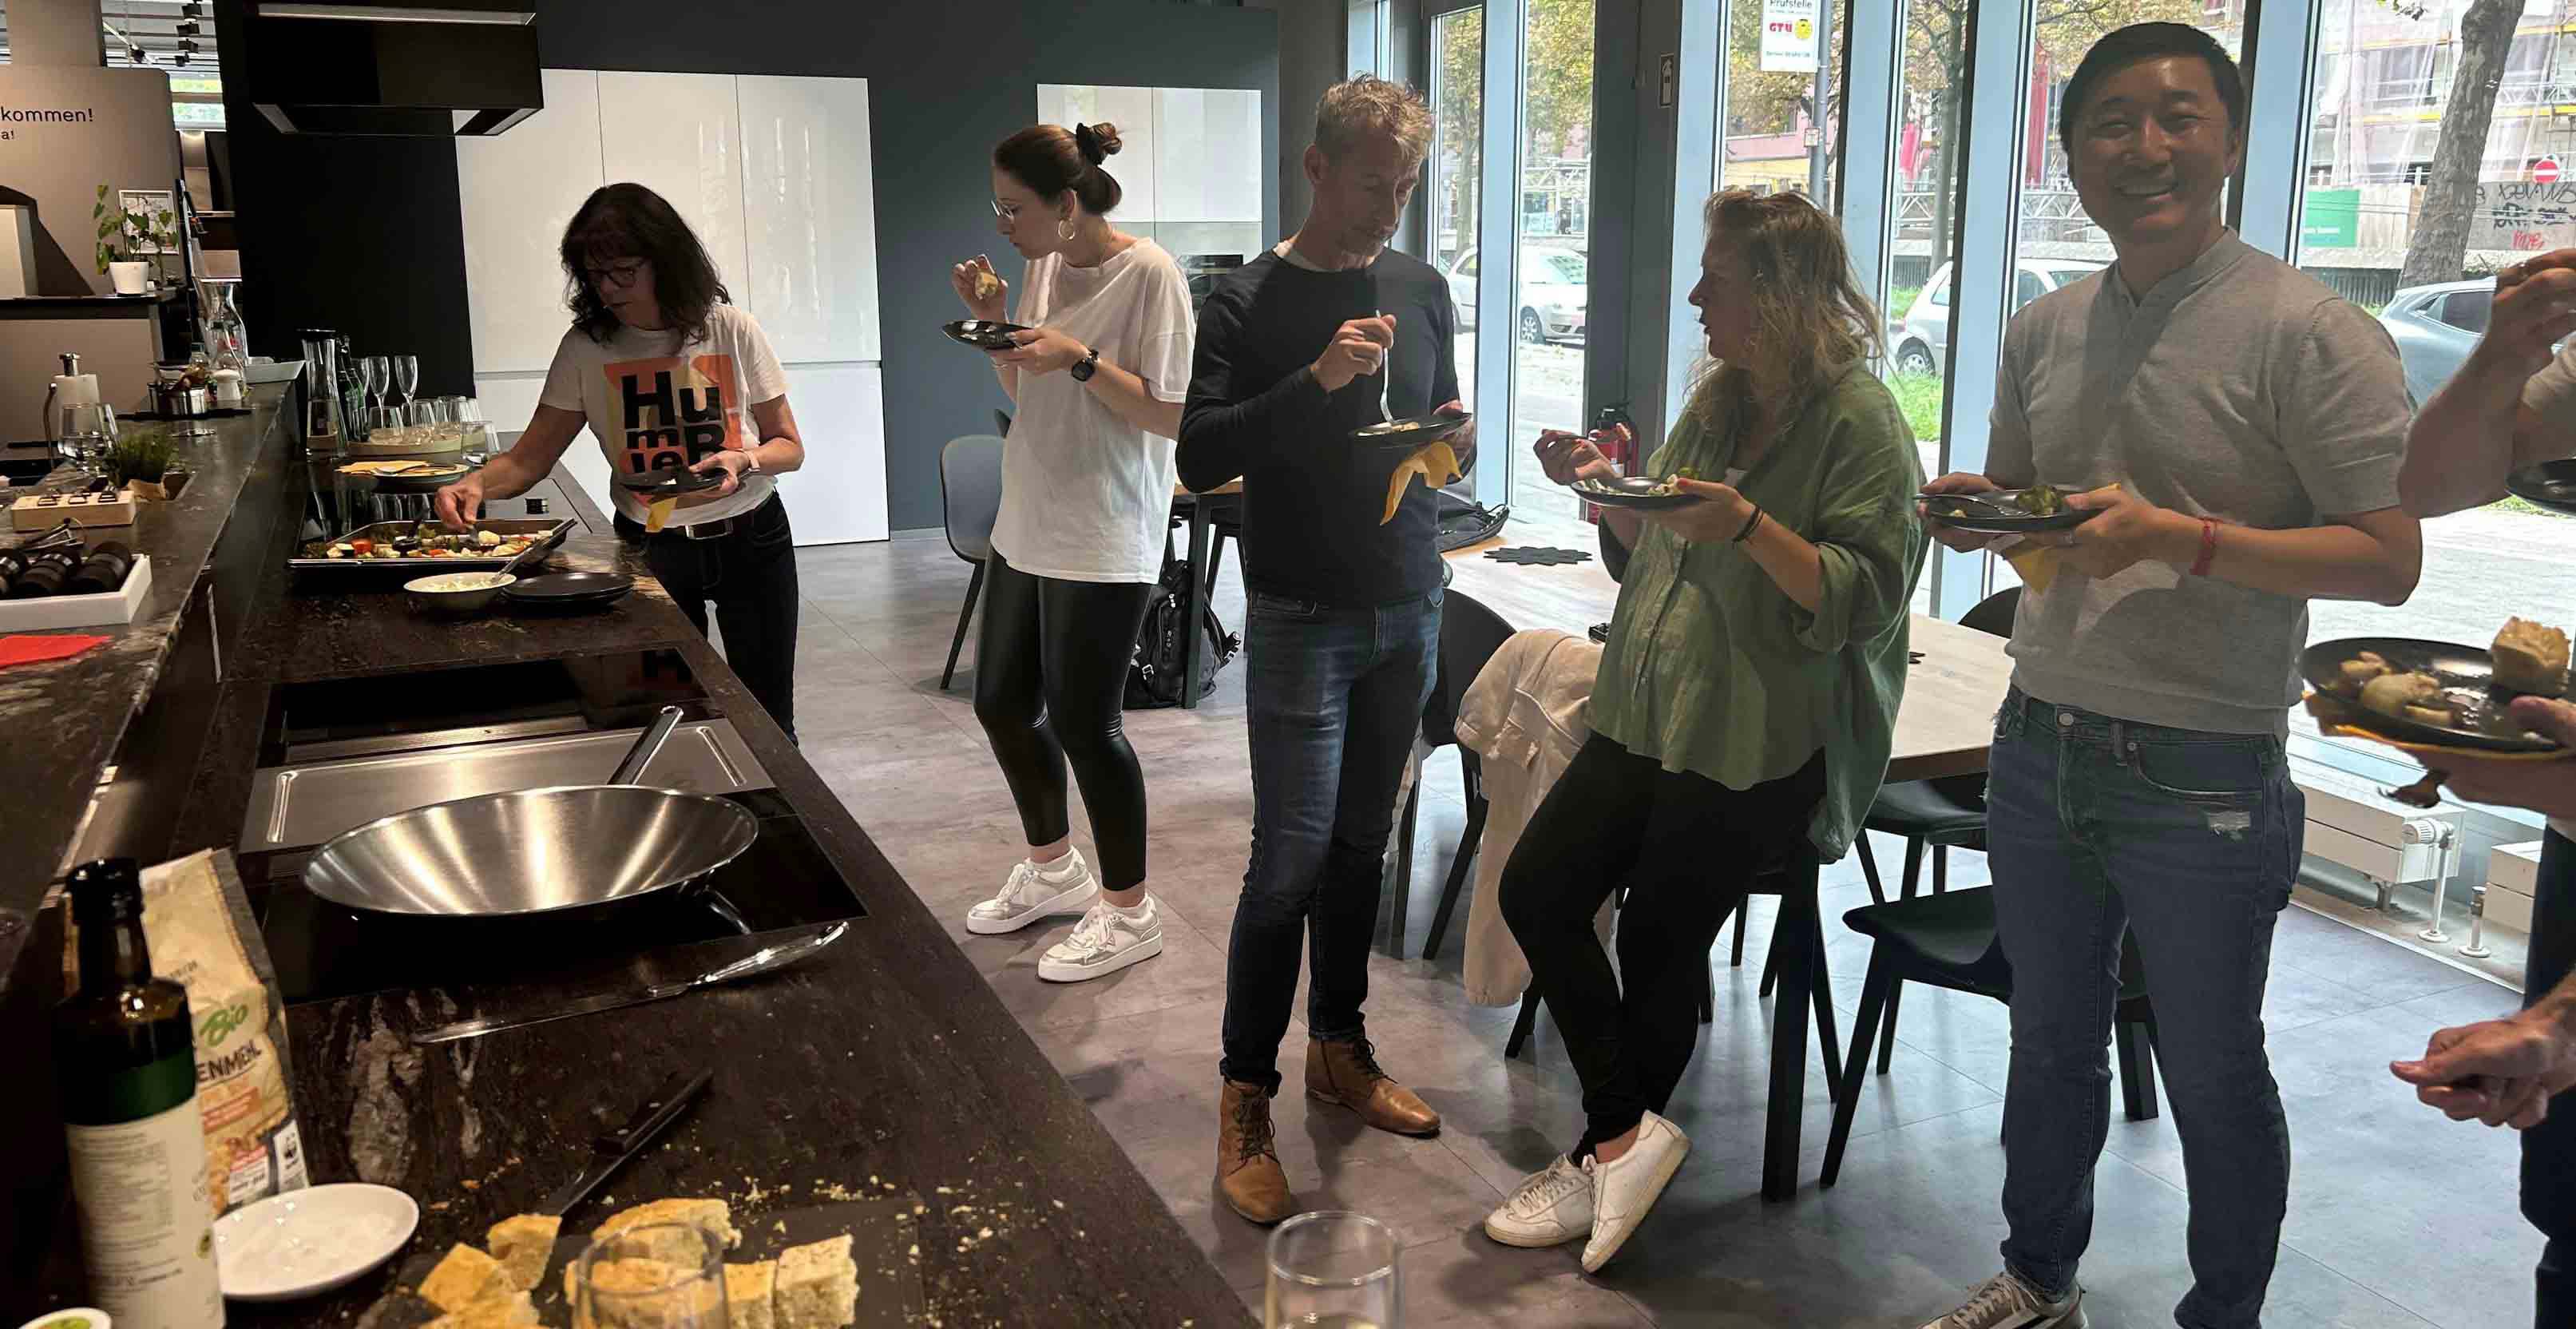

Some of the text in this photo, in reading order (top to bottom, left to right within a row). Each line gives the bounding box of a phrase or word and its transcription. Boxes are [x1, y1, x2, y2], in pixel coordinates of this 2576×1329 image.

[0, 105, 93, 122] kommen!
[1, 130, 14, 140] a!
[199, 1003, 248, 1046] Bio
